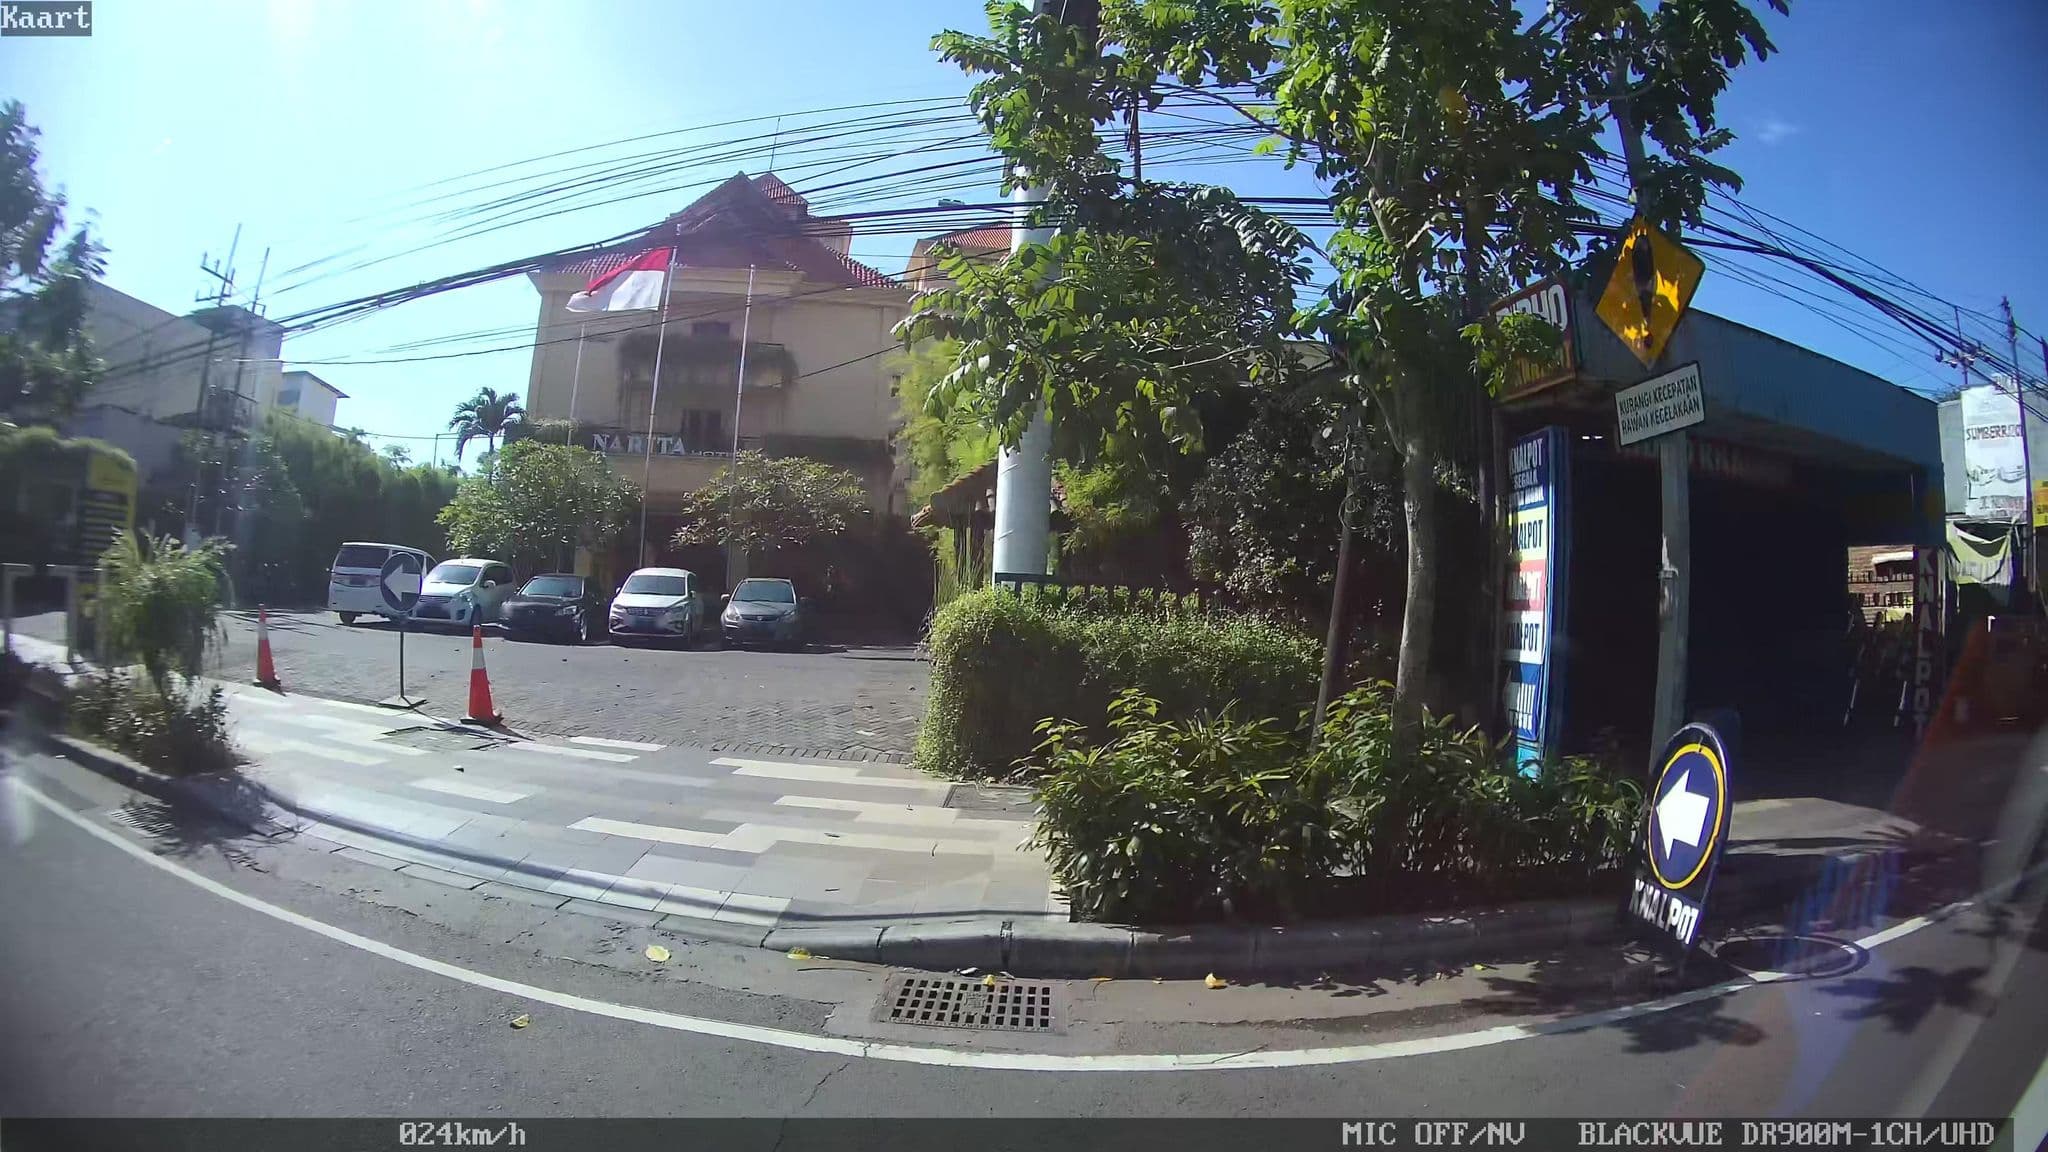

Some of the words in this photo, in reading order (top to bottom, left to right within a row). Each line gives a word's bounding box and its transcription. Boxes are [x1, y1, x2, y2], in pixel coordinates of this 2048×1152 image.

[1618, 391, 1652, 416] KURANGI
[1653, 375, 1697, 404] KECEPATAN
[1621, 411, 1649, 435] RAWAN
[1650, 397, 1700, 426] KECELAKAAN
[592, 432, 686, 456] NARITA
[1628, 878, 1700, 945] KNALPOT
